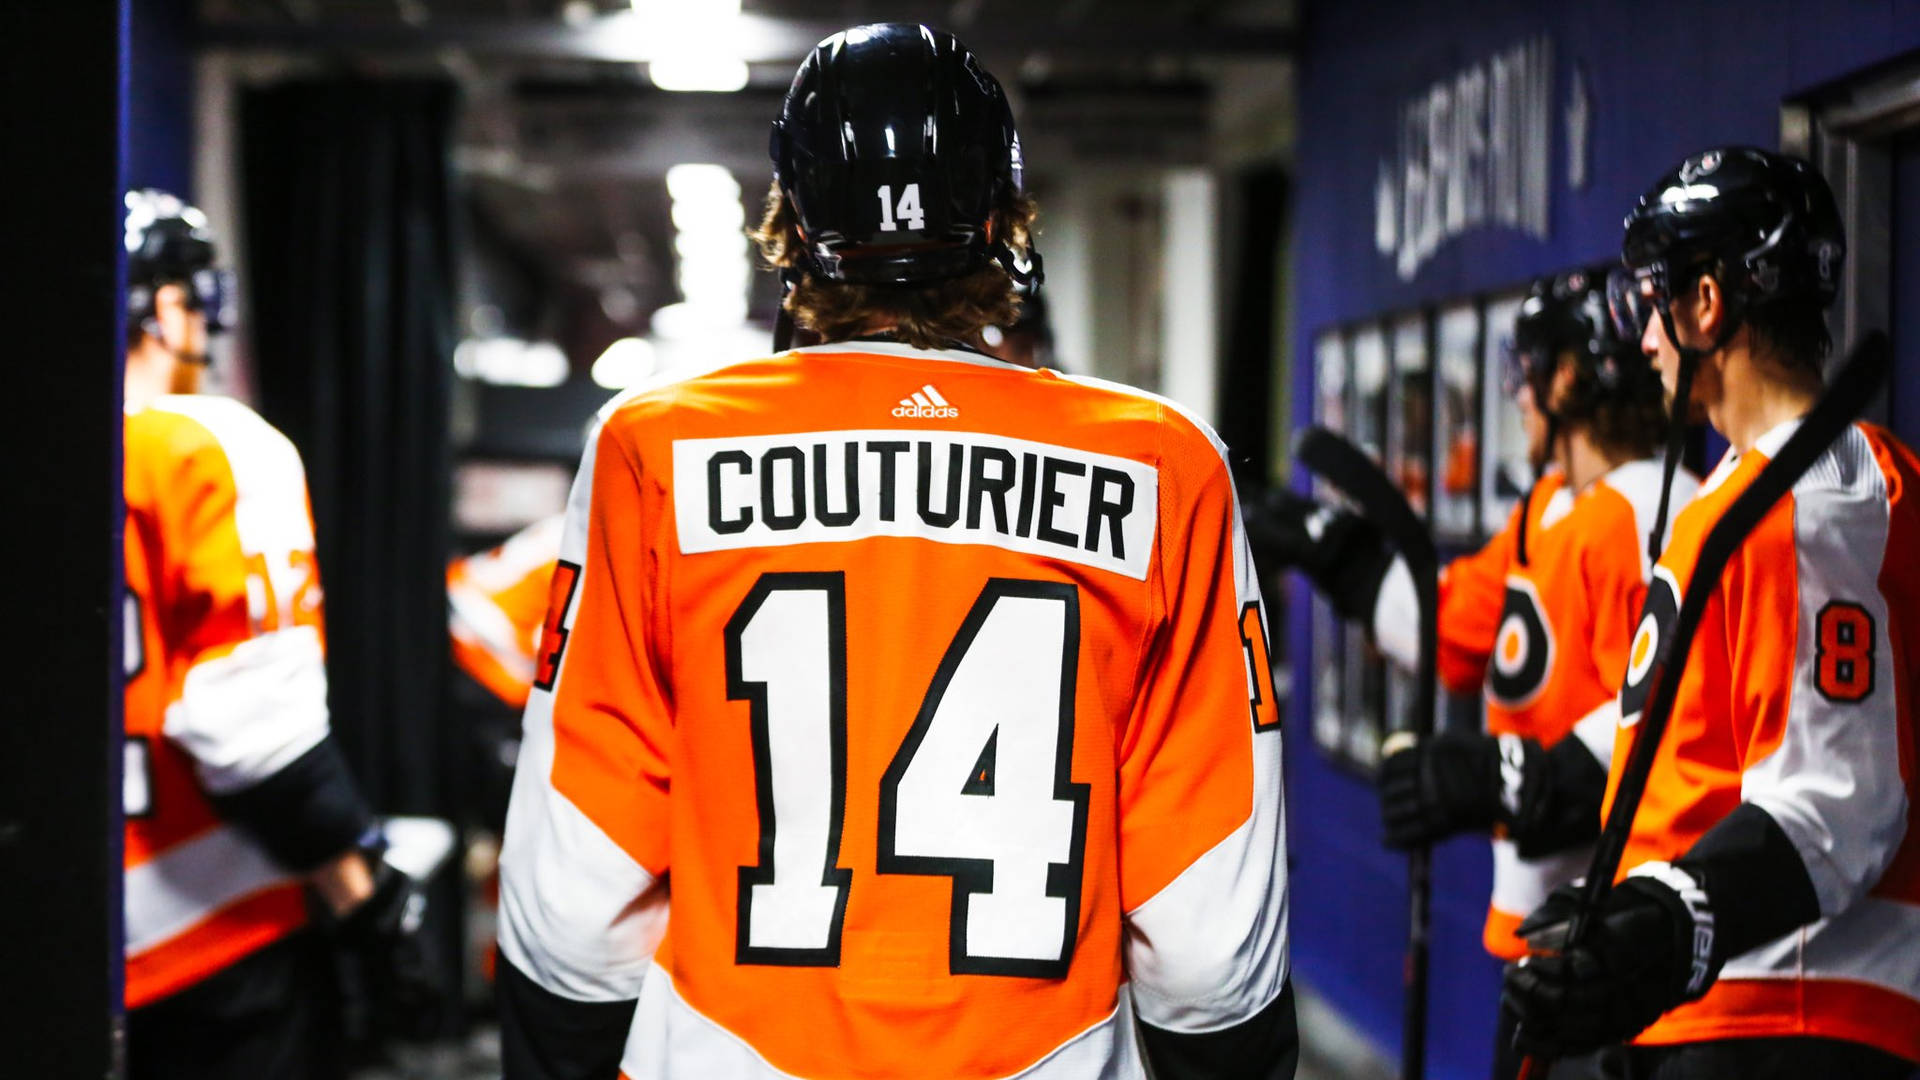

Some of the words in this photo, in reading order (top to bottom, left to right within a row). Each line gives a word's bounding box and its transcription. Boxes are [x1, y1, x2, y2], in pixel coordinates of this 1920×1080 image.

[877, 183, 925, 231] 14
[891, 405, 959, 418] adidas
[707, 440, 1135, 560] COUTURIER
[1814, 600, 1876, 704] 8
[723, 570, 1091, 980] 14
